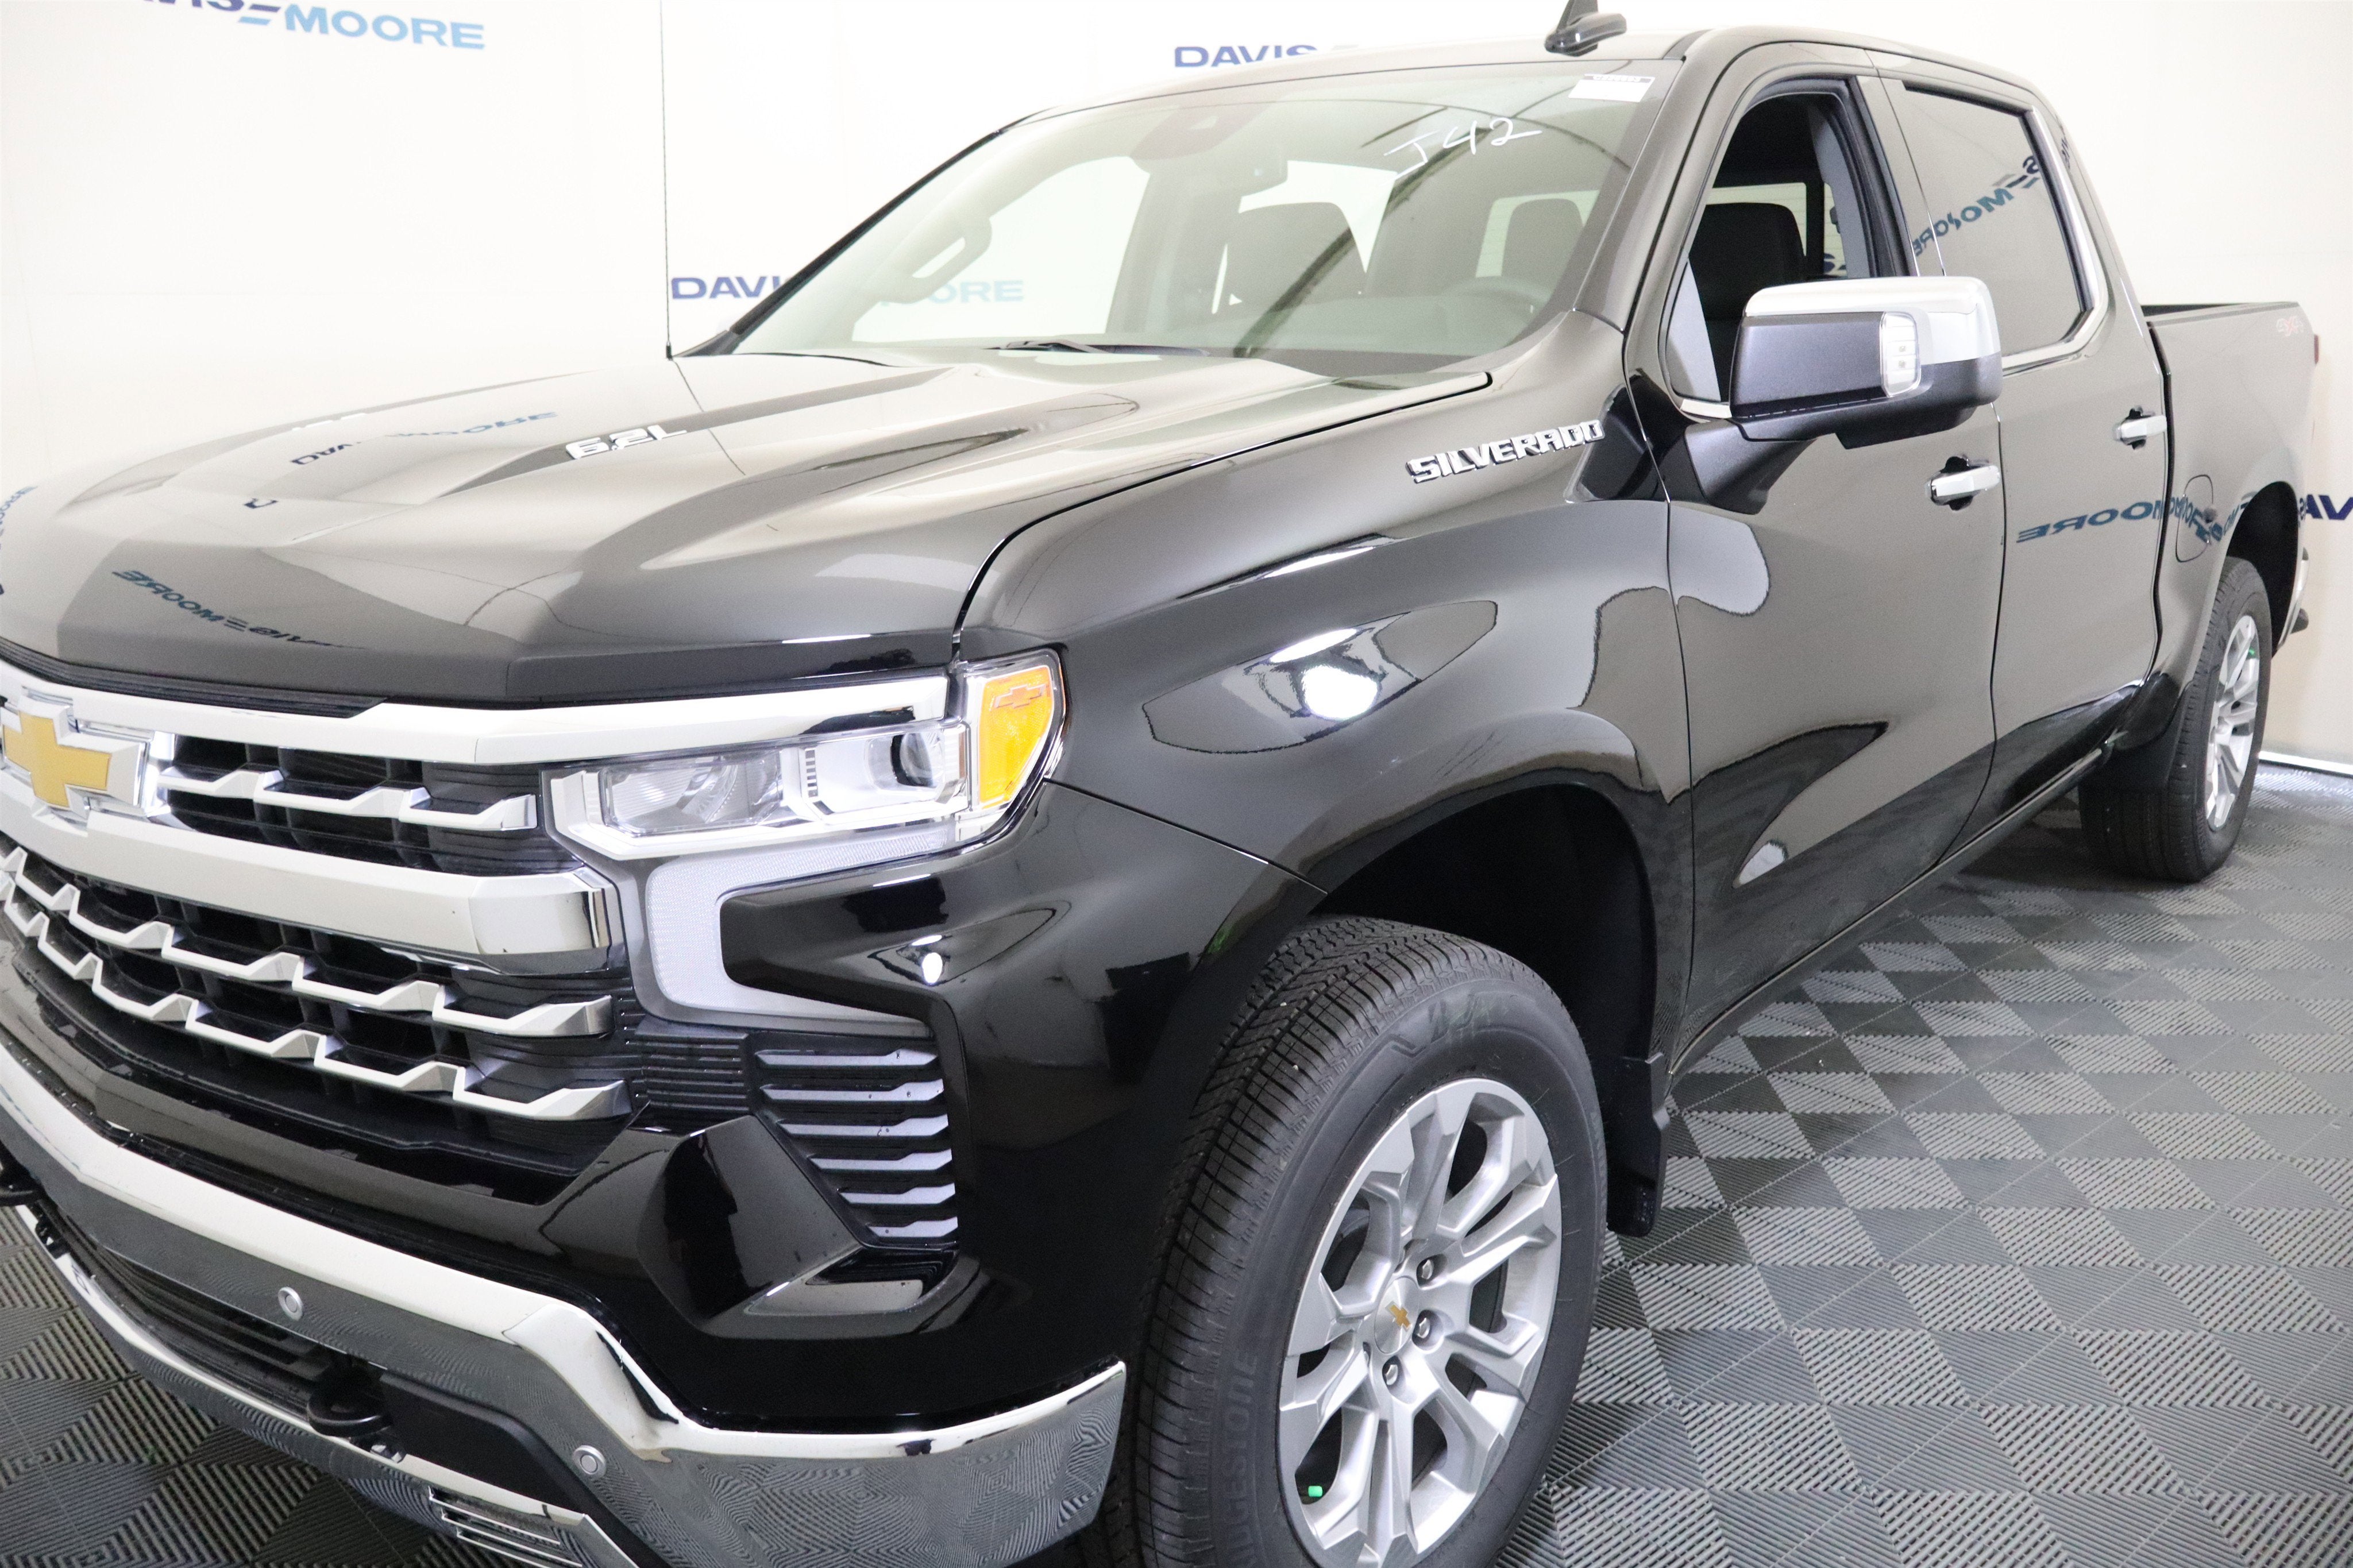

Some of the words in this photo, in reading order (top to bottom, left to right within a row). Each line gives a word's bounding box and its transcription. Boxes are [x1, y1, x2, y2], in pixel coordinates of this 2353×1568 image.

[284, 3, 486, 50] MOORE
[671, 275, 789, 299] DAVI
[565, 424, 688, 459] 6.2L
[1405, 419, 1605, 484] SILVERADO
